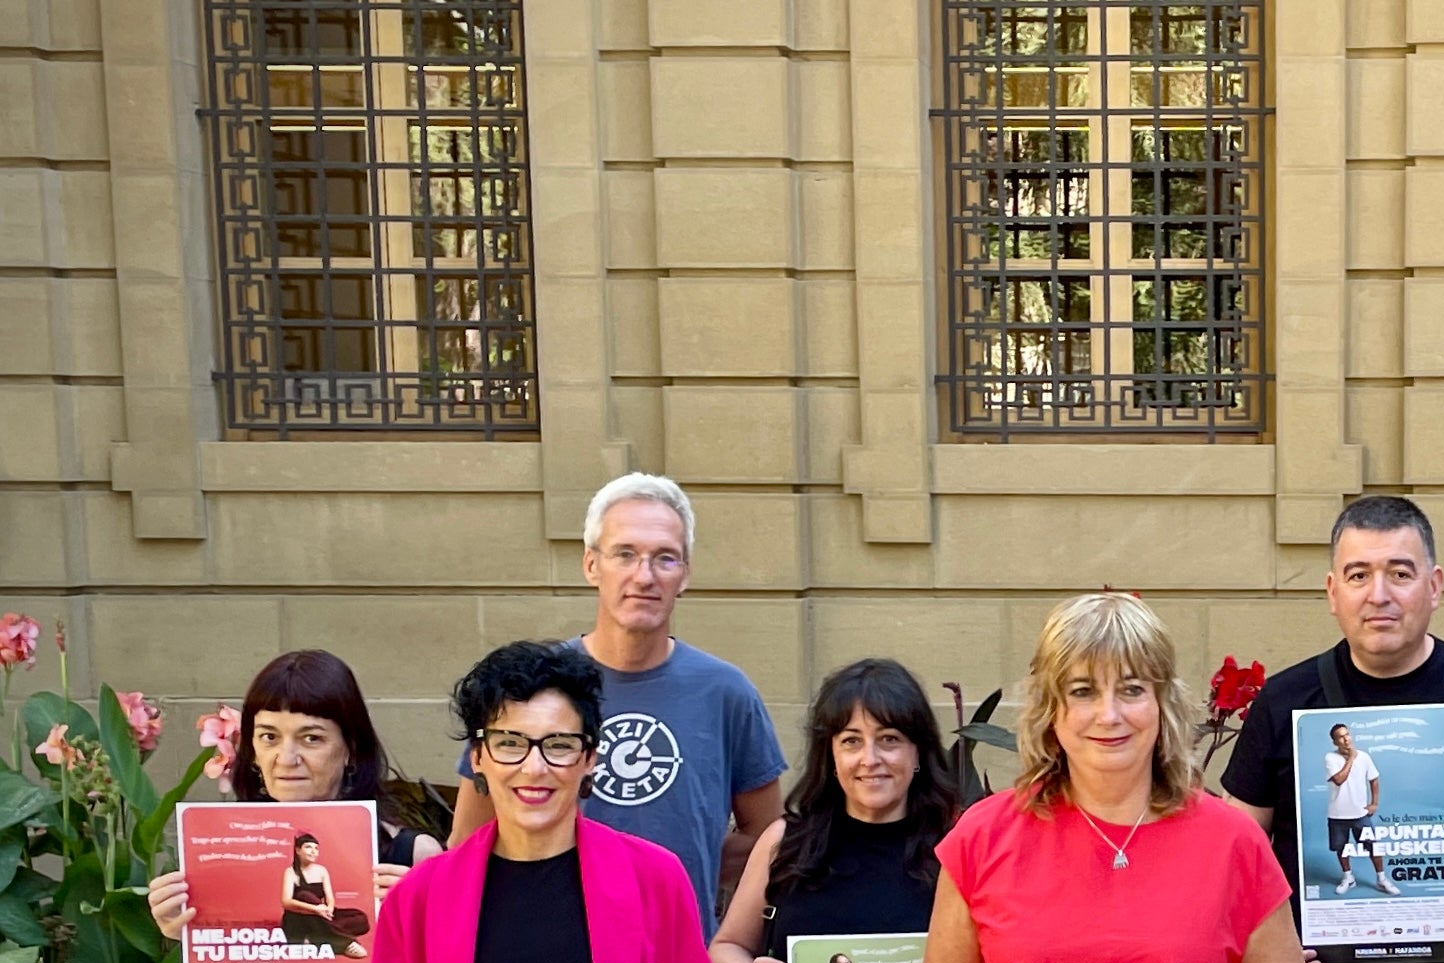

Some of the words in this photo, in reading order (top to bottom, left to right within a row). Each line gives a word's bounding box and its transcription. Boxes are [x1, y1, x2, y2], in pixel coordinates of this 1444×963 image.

[1342, 842, 1372, 858] AL
[192, 928, 287, 944] MEJORA
[193, 945, 225, 961] TU
[228, 944, 335, 961] EUSKERA
